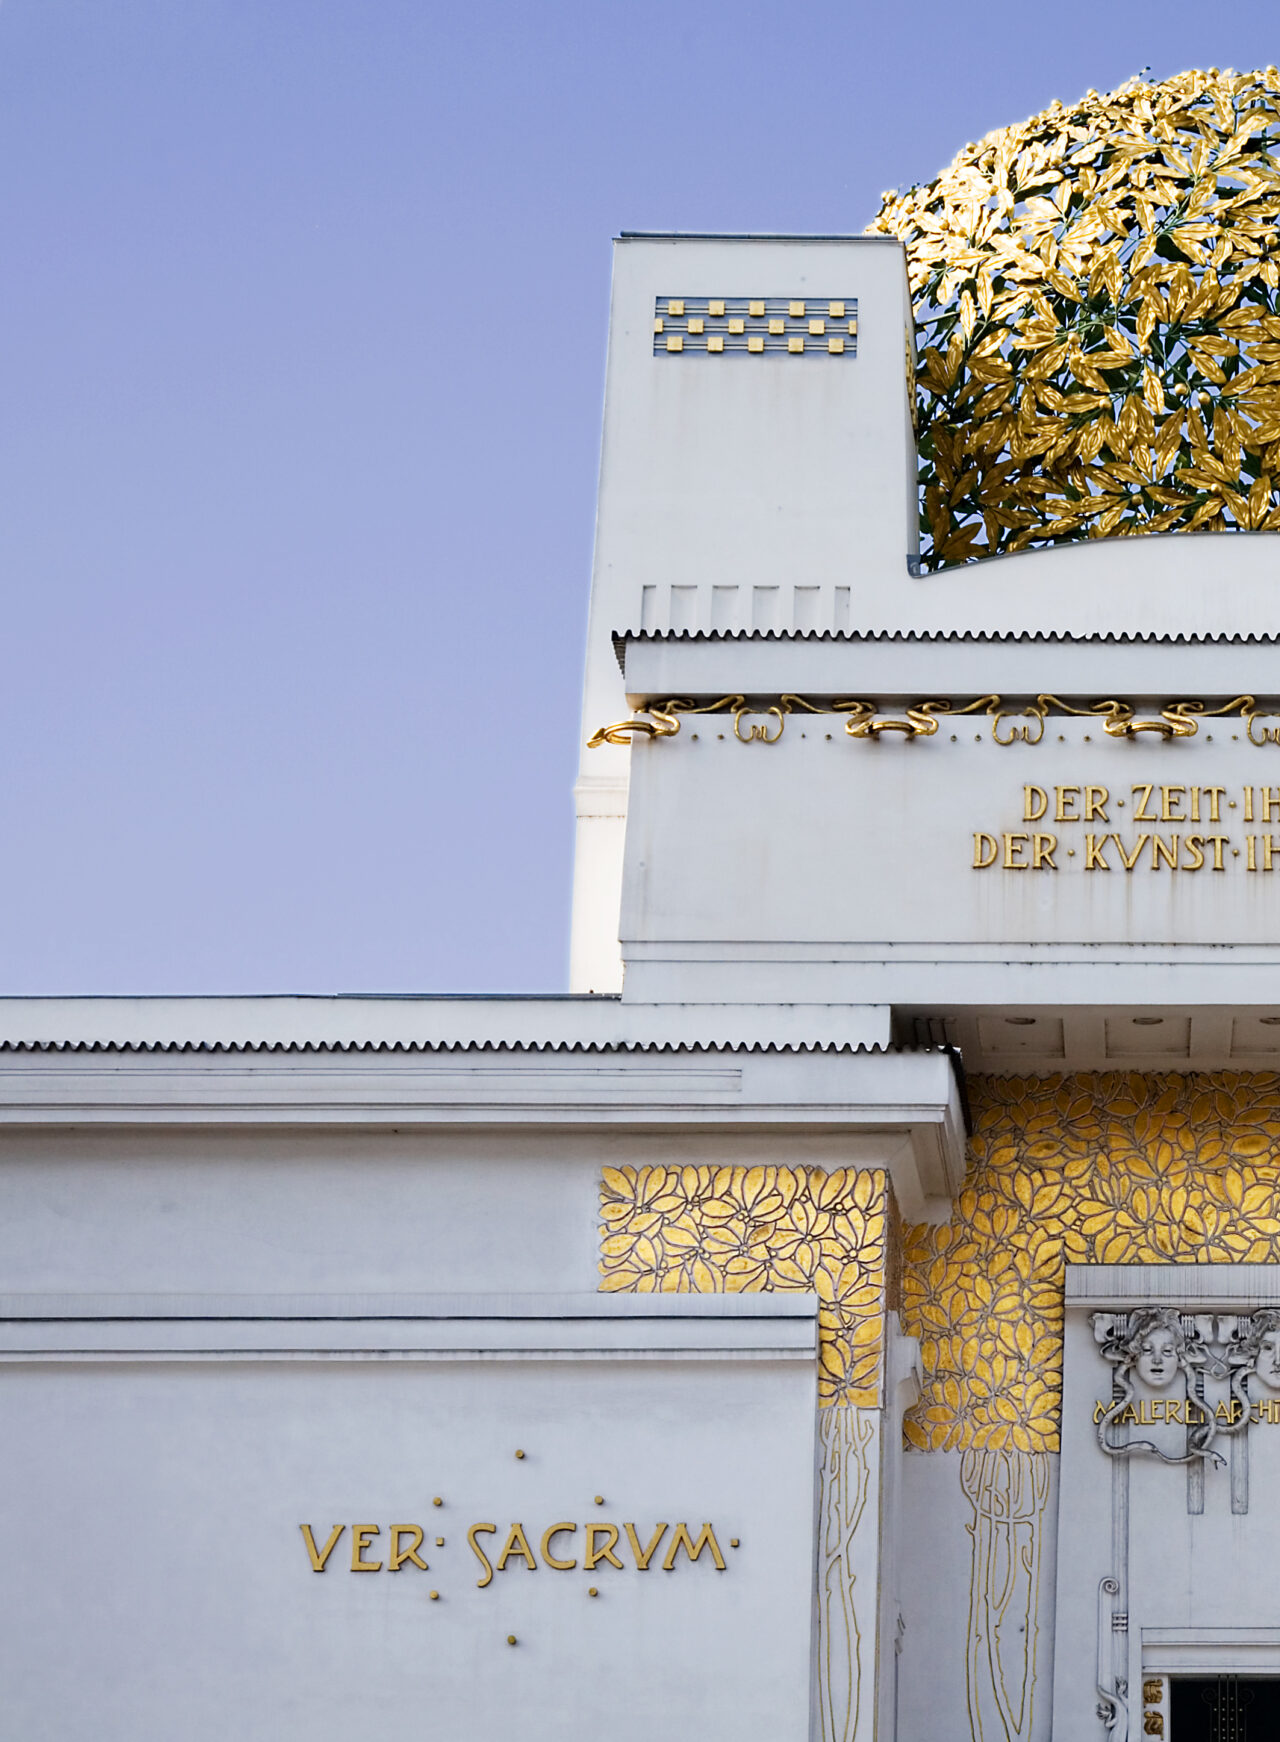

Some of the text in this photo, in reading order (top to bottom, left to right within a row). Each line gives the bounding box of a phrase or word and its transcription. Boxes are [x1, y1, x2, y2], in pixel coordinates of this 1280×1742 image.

[1022, 785, 1110, 822] DER
[1131, 784, 1227, 823] ZEIT
[972, 832, 1059, 871] DER
[1085, 833, 1230, 872] KVNST
[301, 1522, 726, 1588] VER SACRVM
